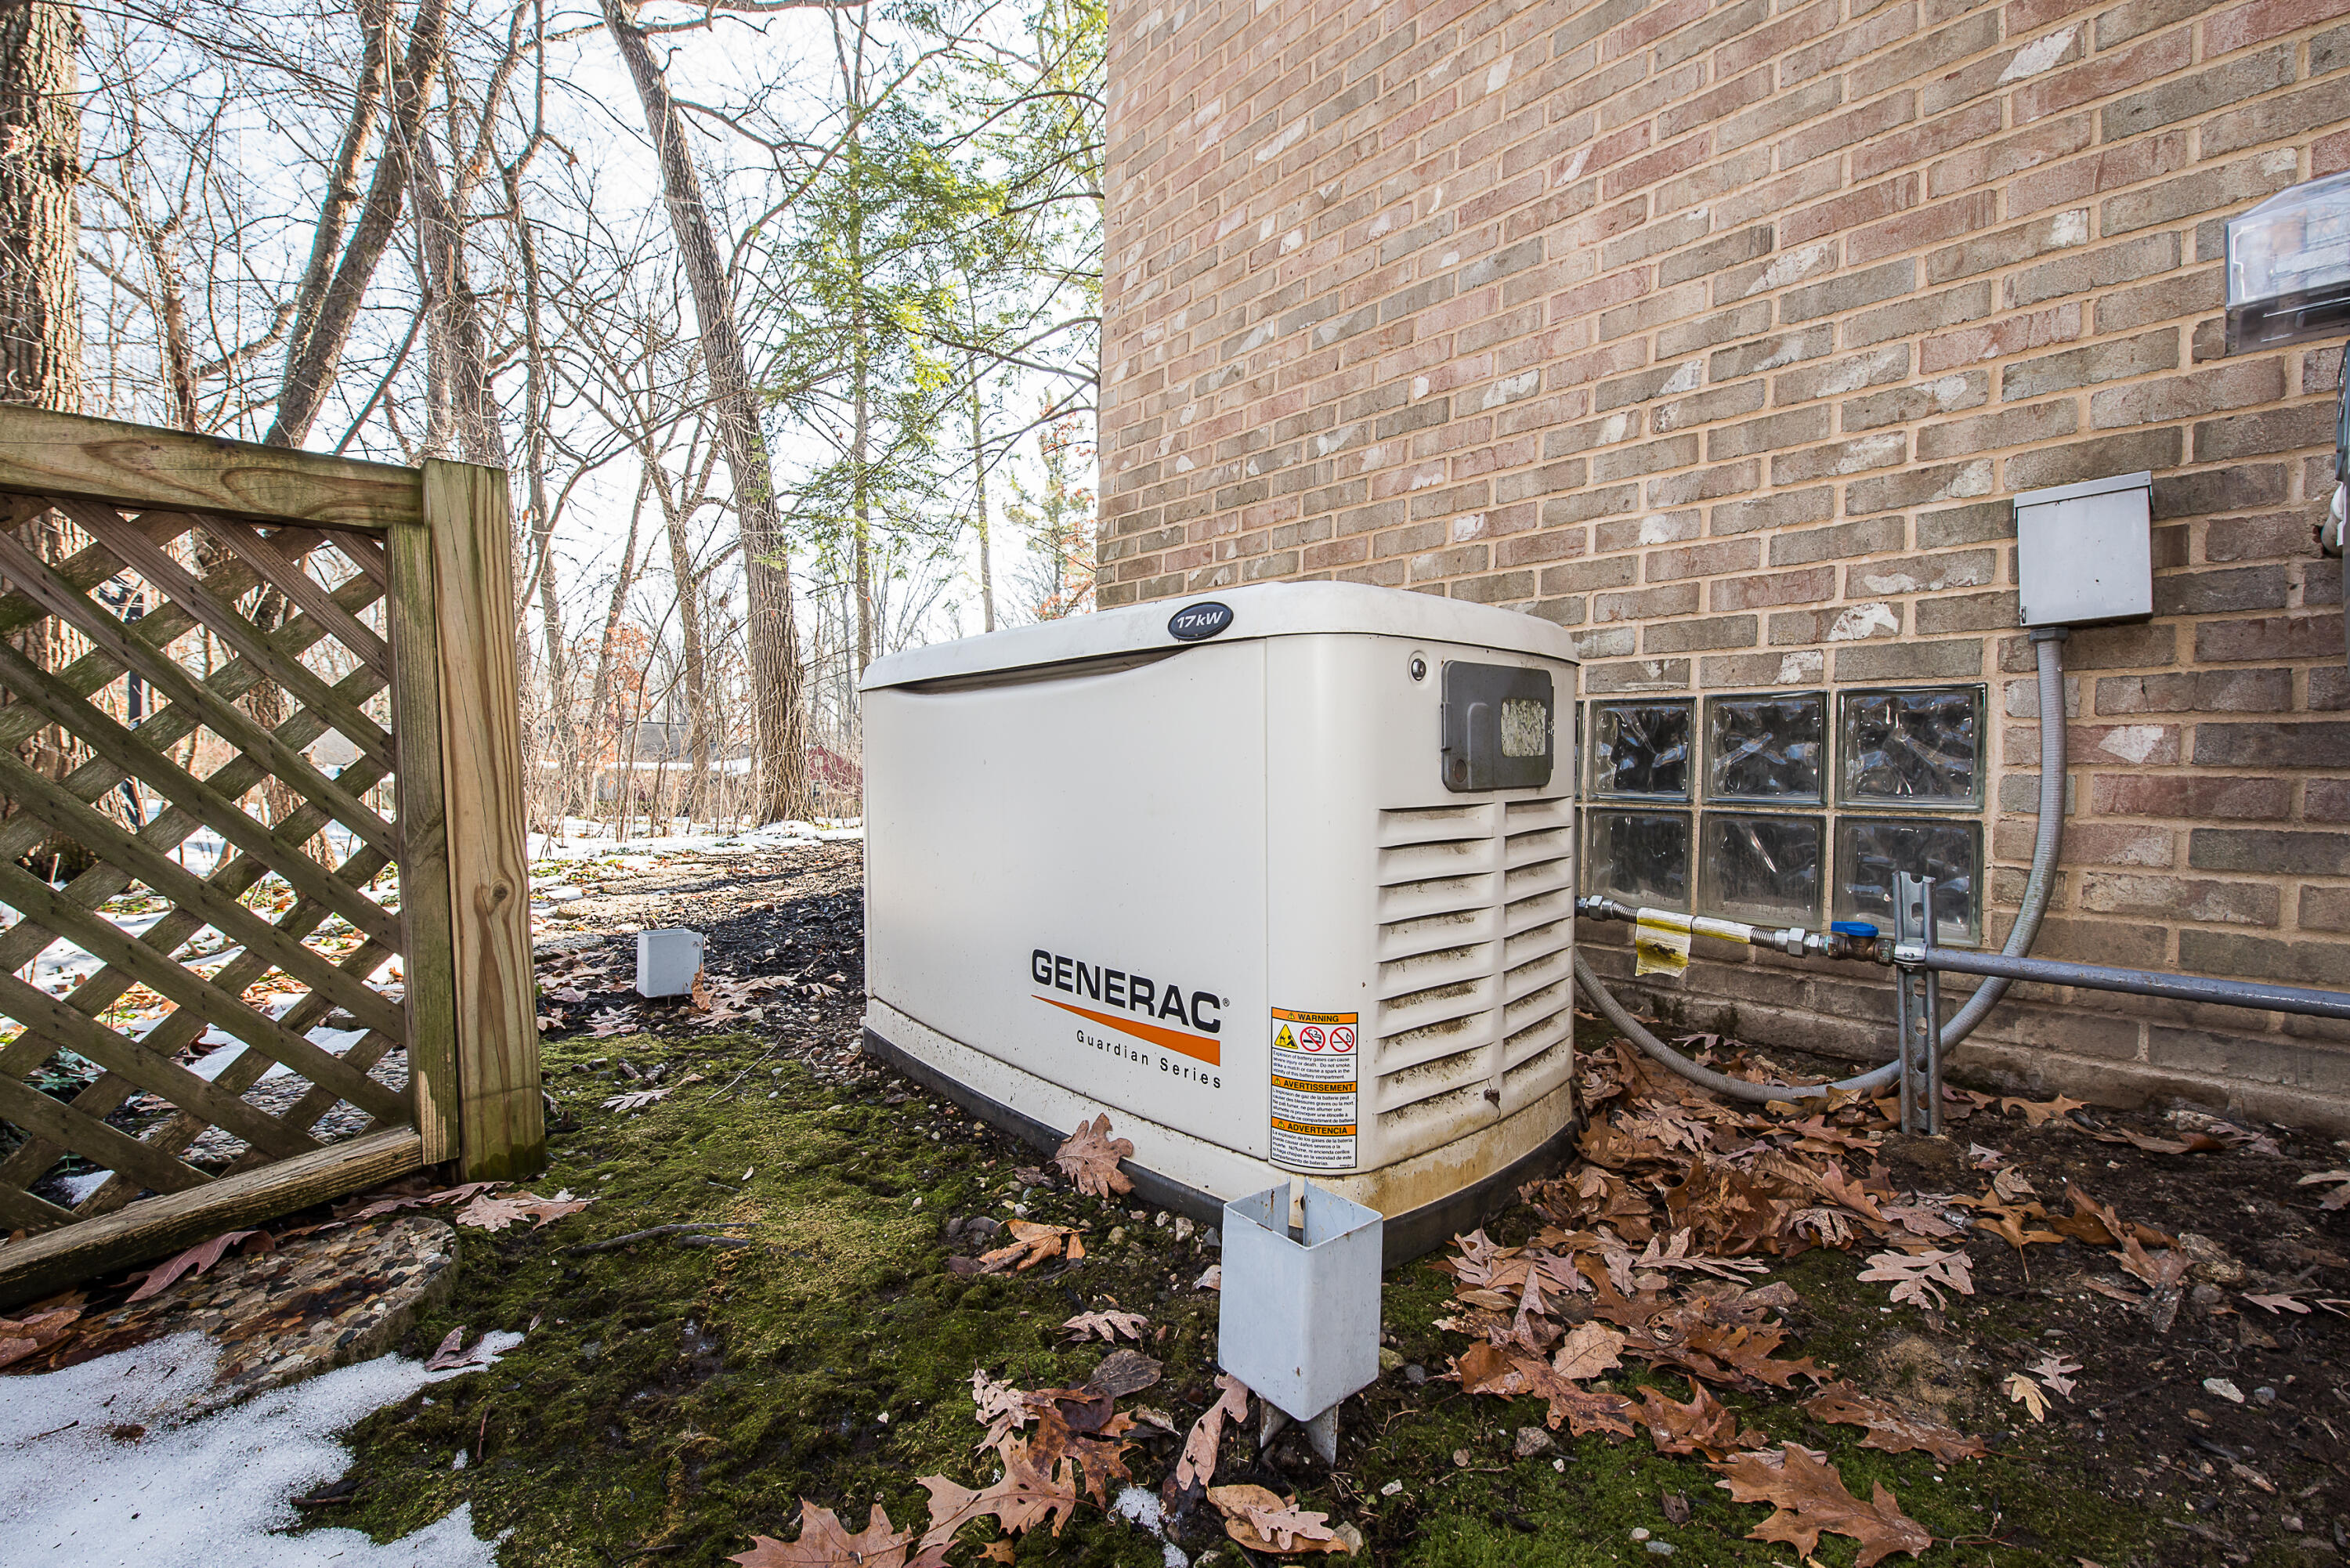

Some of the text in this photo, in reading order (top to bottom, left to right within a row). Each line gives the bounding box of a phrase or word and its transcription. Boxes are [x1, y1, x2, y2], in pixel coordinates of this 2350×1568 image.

[1031, 948, 1221, 1034] GENERAC
[1298, 1013, 1339, 1022] WARNING
[1076, 1030, 1221, 1089] Guardian Series
[1283, 1080, 1353, 1091] AVERTISSEMENT
[1287, 1123, 1347, 1134] ADVERTENCIA
